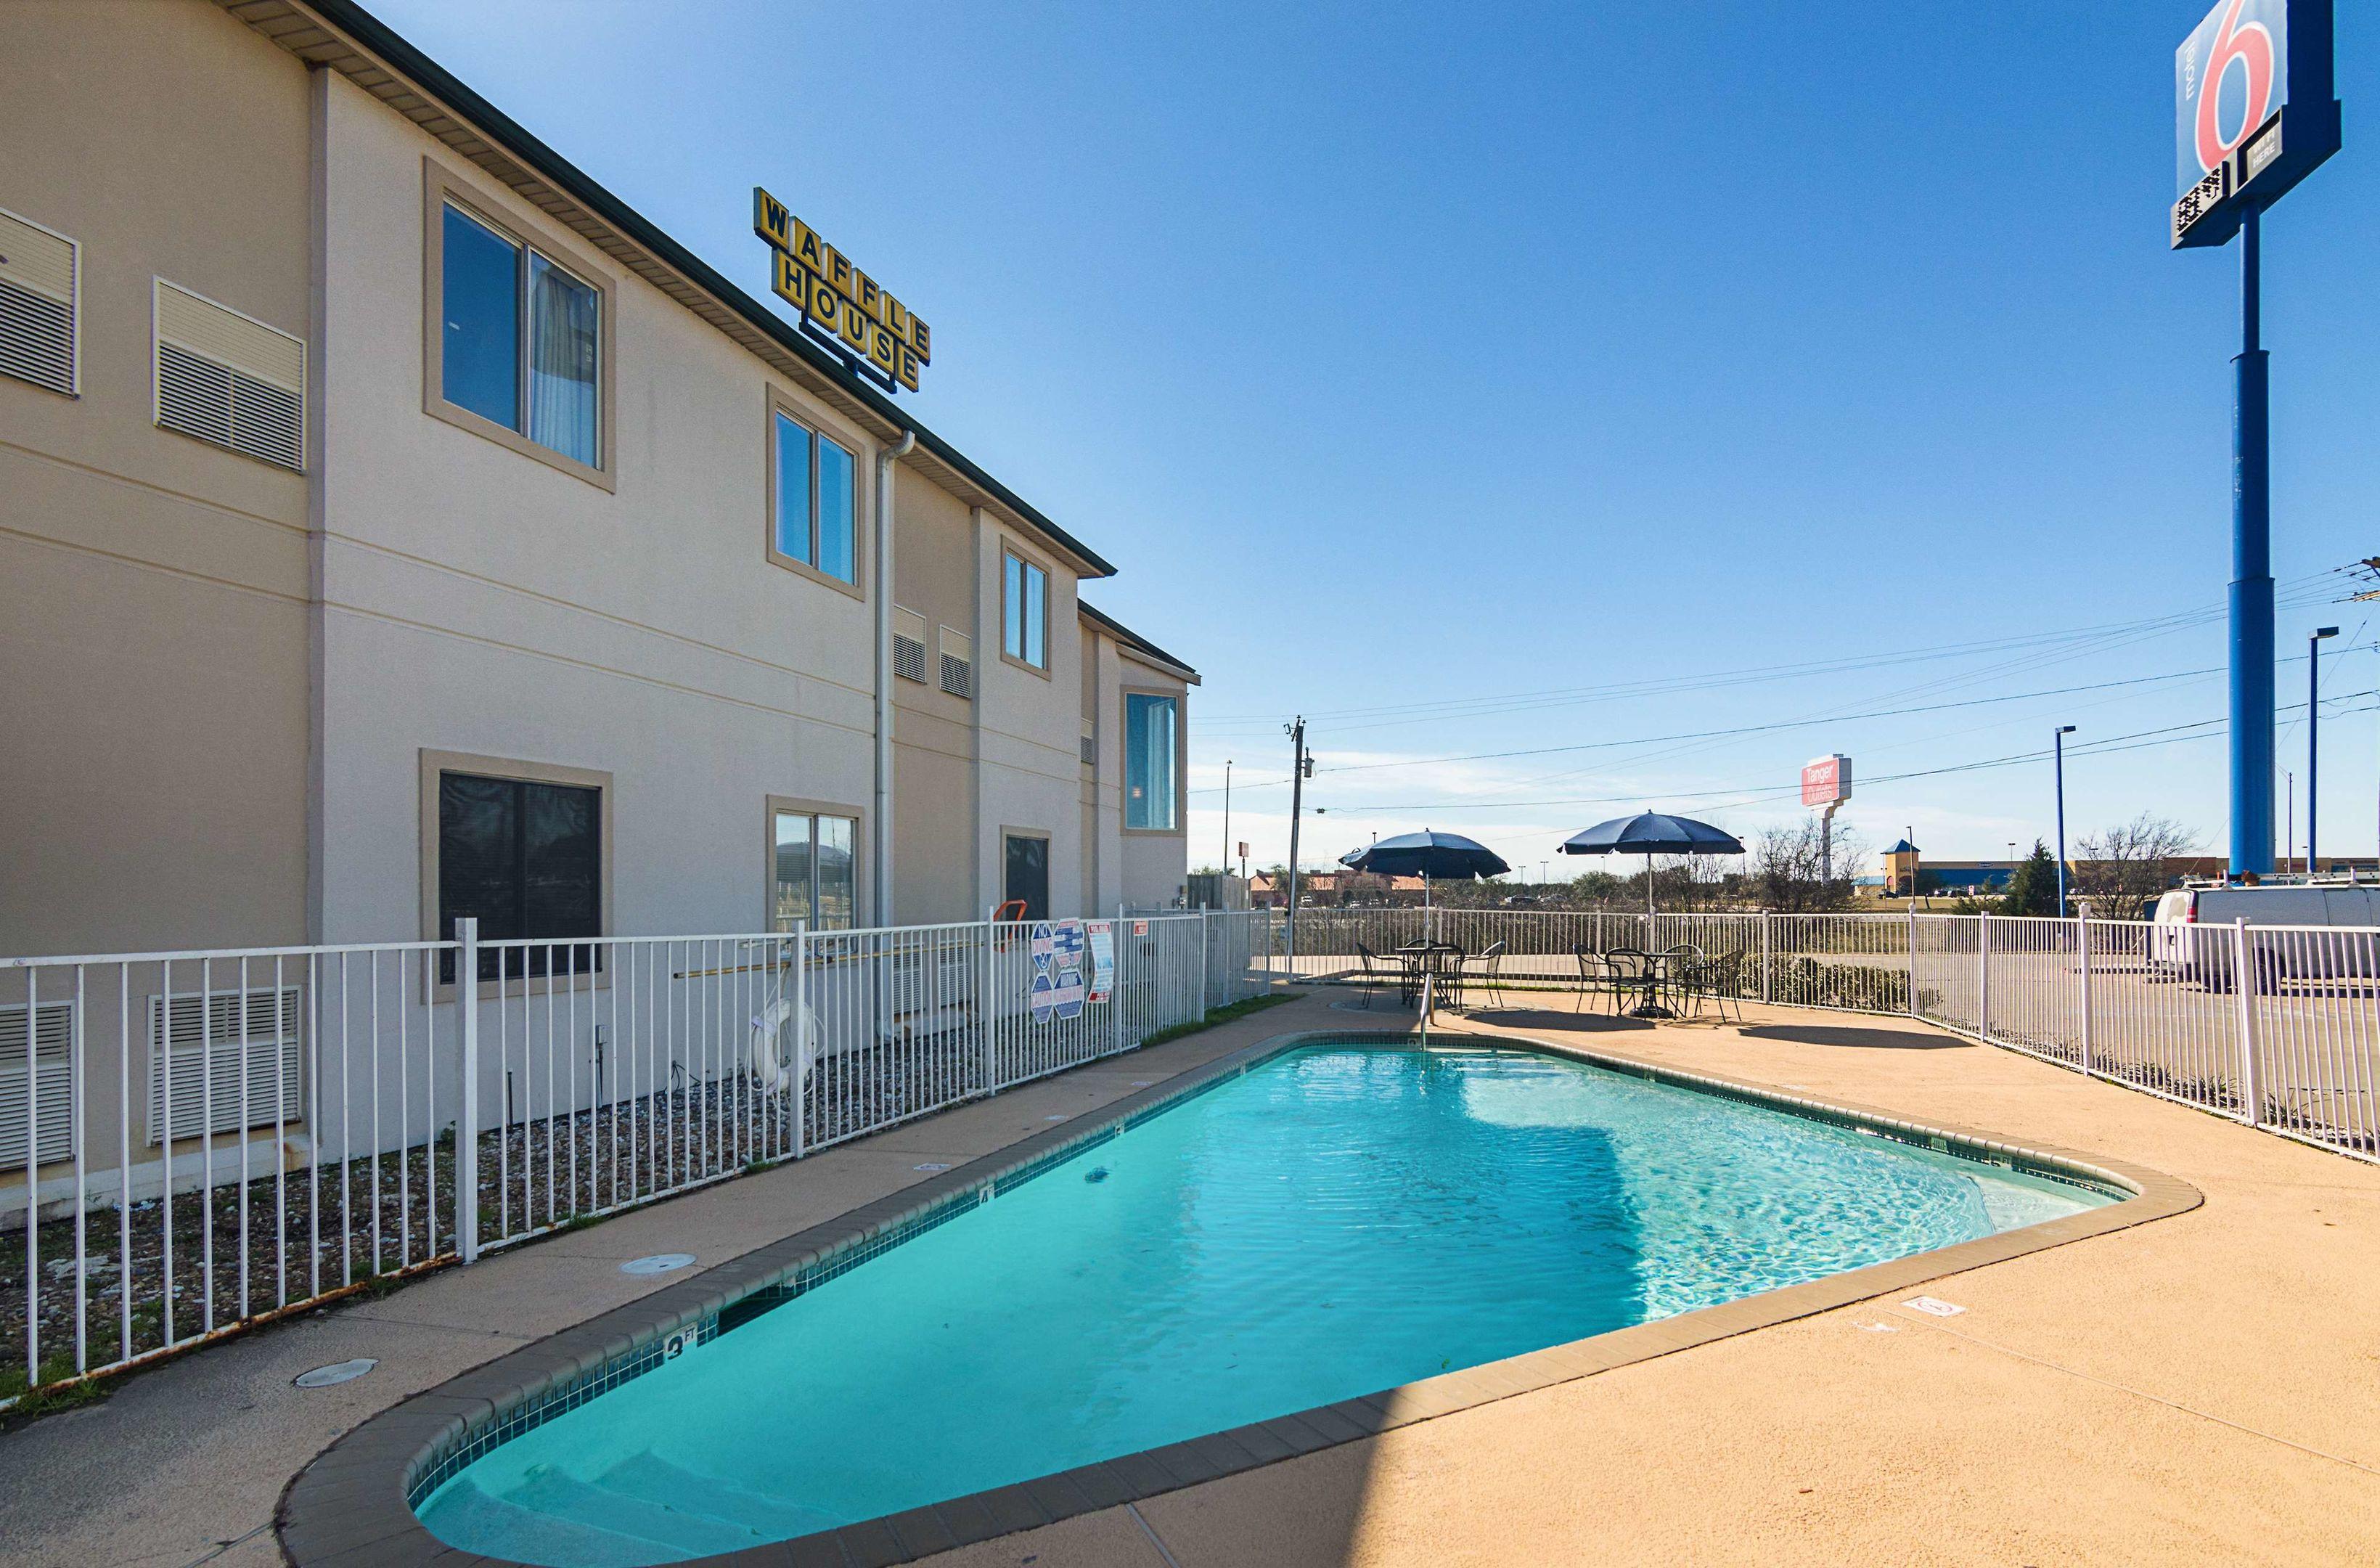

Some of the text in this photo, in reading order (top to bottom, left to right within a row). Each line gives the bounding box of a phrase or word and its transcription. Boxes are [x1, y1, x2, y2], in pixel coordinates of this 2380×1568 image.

[2184, 0, 2275, 173] motel 6
[2253, 142, 2276, 168] HERE
[766, 197, 928, 353] WAFFLE
[785, 259, 917, 383] HOUSE
[1807, 764, 1834, 783] Tanger
[1807, 784, 1832, 802] Outlets
[1038, 924, 1047, 938] NO
[1033, 938, 1052, 955] DIVING
[667, 1327, 695, 1360] 3 FT
